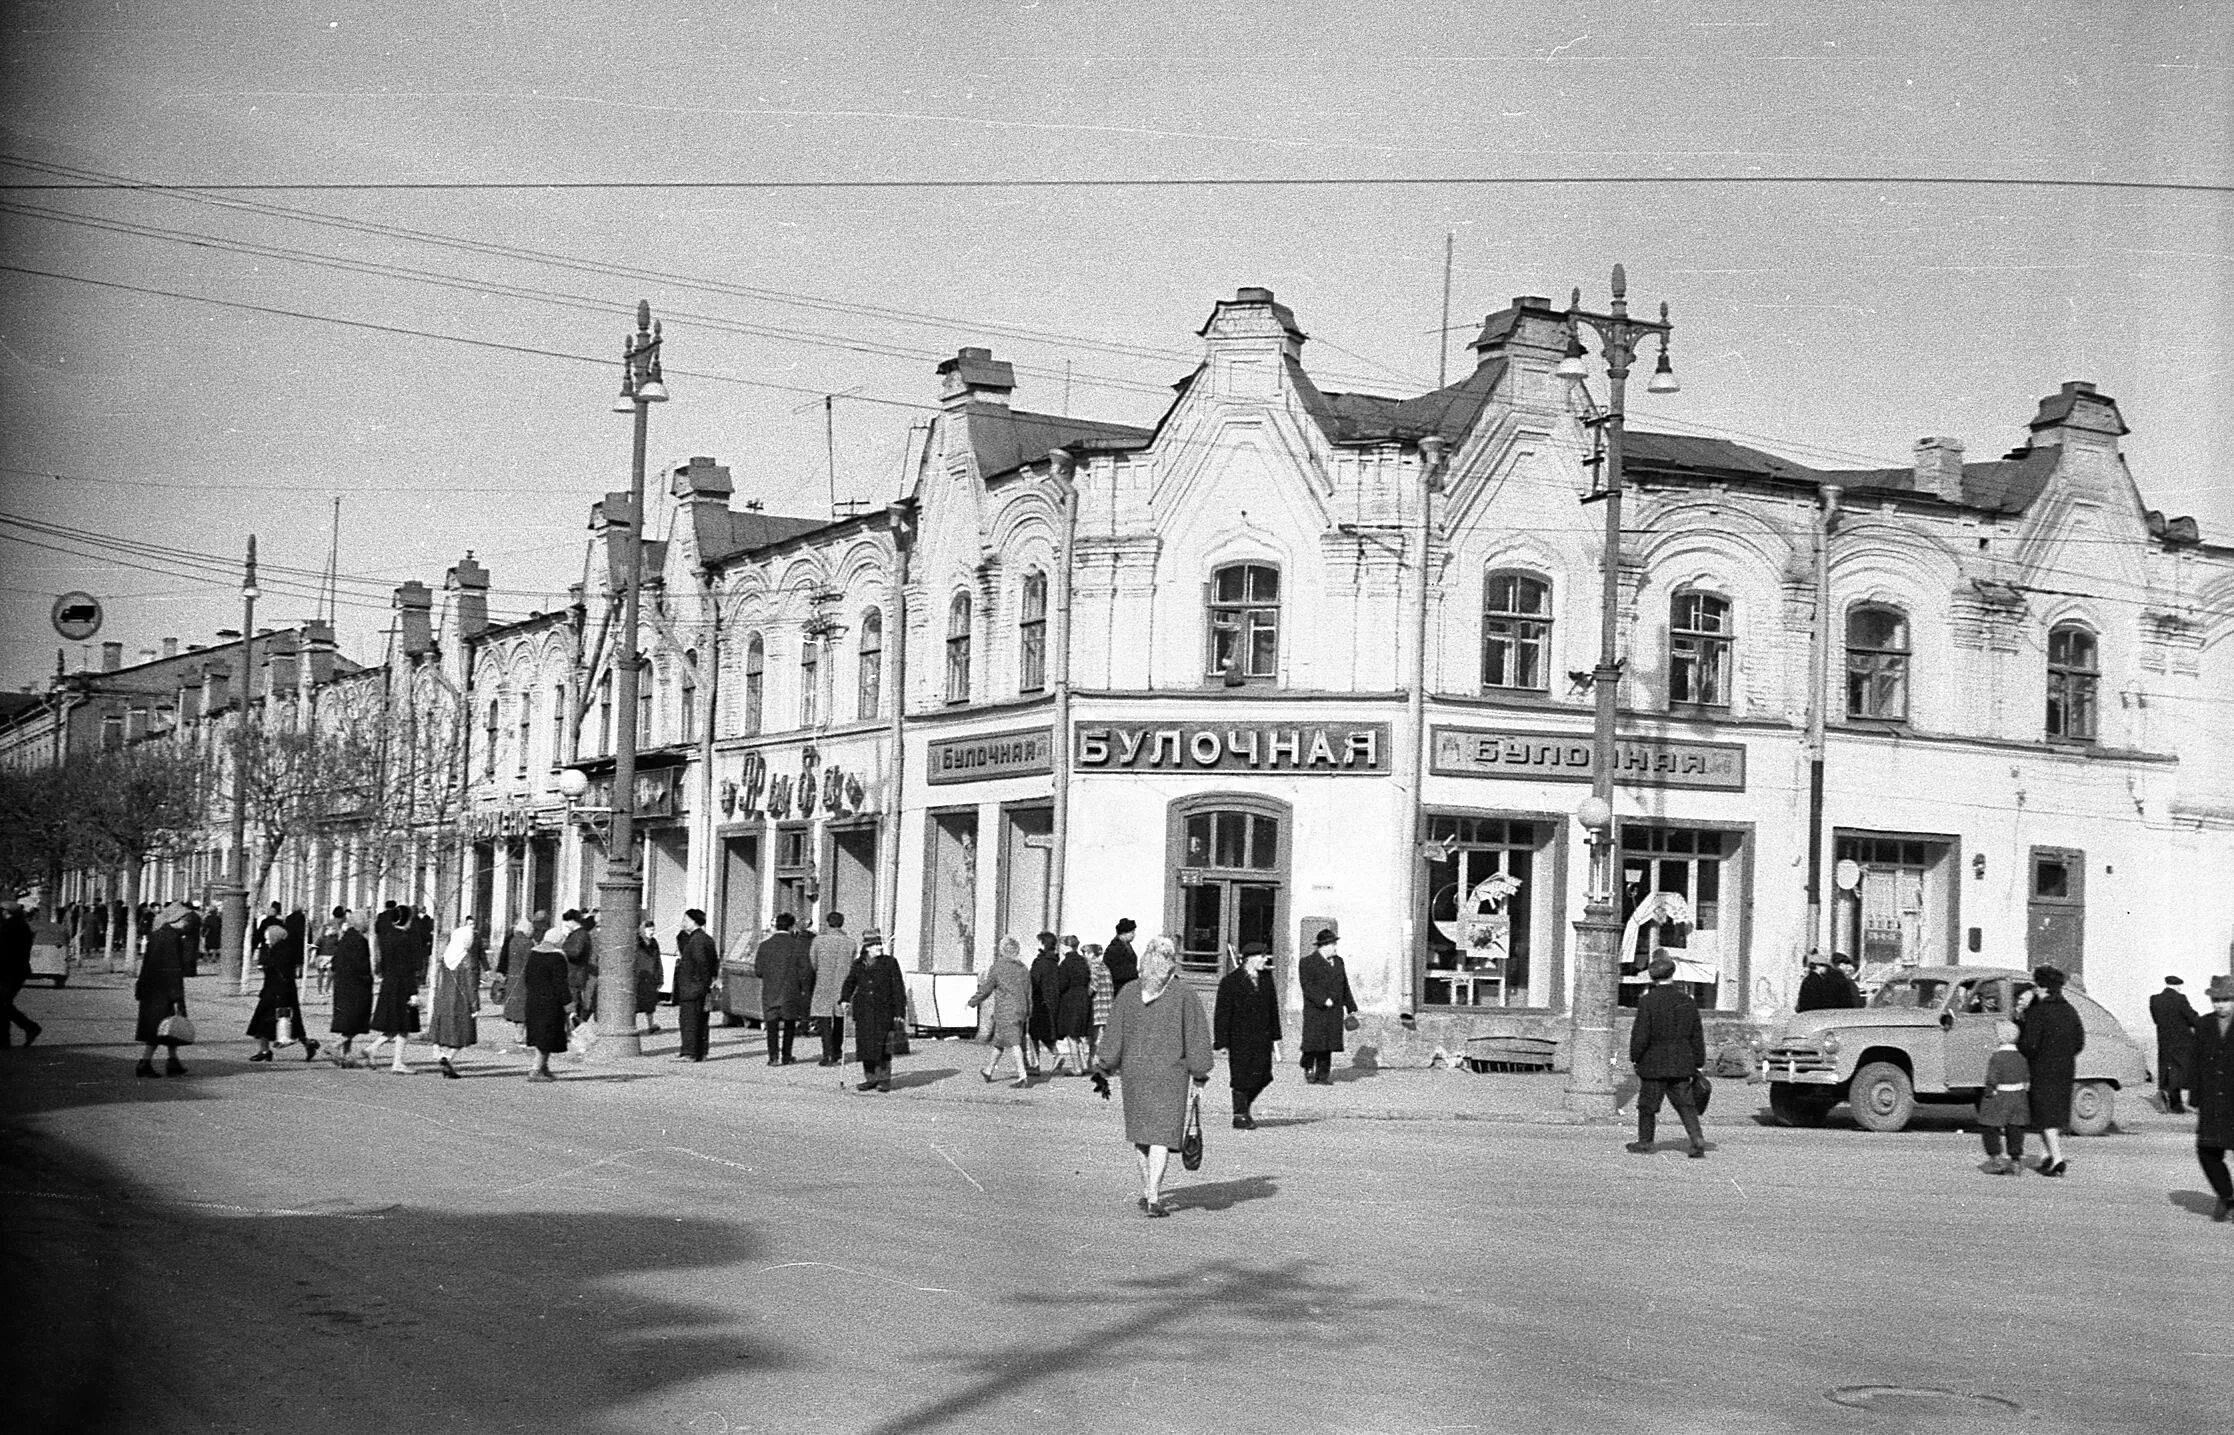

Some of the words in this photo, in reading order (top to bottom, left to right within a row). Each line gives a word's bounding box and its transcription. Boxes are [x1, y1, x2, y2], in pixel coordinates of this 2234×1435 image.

[942, 740, 1037, 770] БУЛОЧНАЯ
[1079, 728, 1378, 767] БУЛОЧНАЯ
[1475, 739, 1706, 774] БУЛОНАЯ
